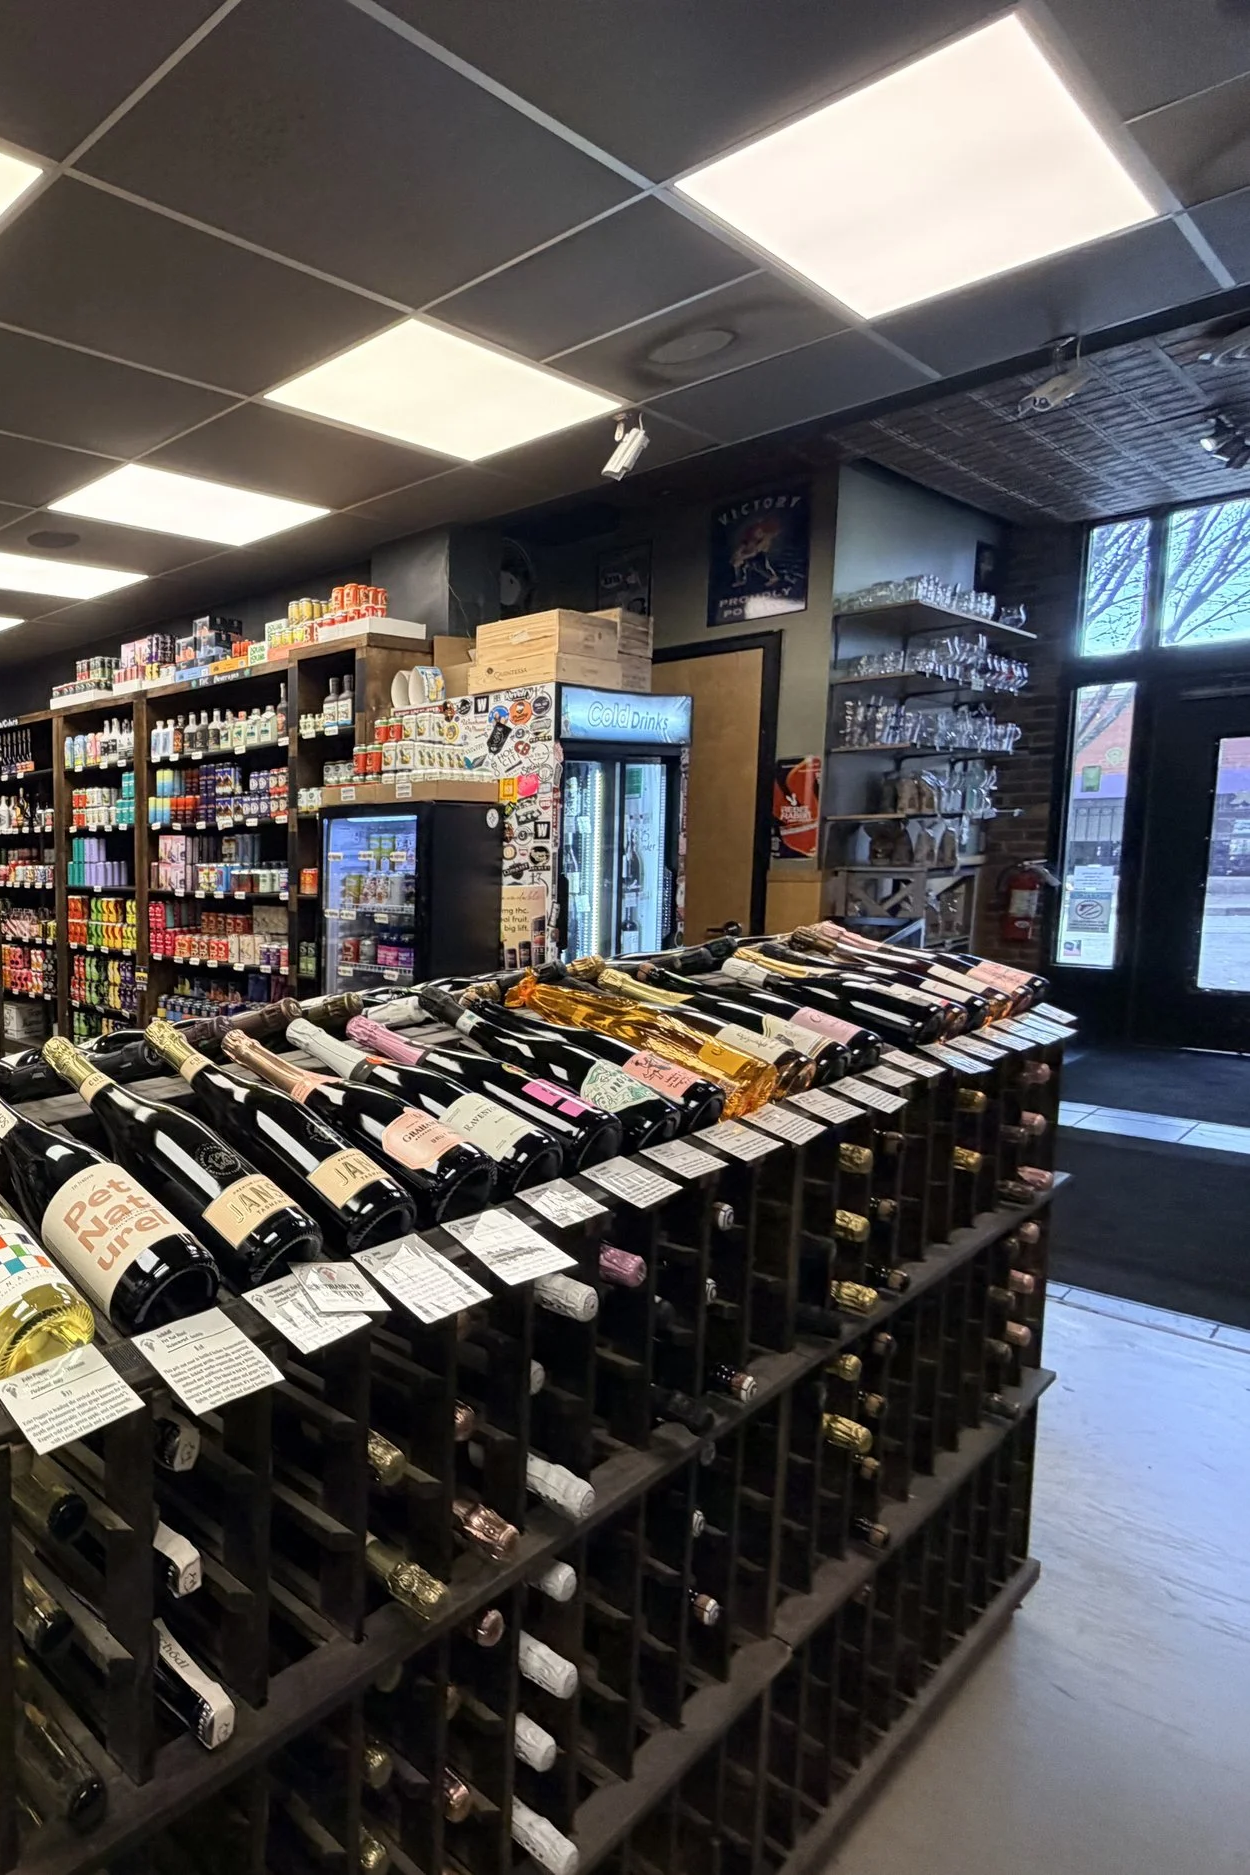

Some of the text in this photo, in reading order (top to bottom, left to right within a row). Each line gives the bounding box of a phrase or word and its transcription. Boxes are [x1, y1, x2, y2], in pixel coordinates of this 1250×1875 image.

[718, 496, 801, 526] VICTORY
[587, 700, 669, 731] Cold Drinks
[504, 924, 529, 933] big lift.
[512, 915, 529, 923] fruit.
[63, 1178, 132, 1233] Pét
[77, 1193, 150, 1253] Nat
[97, 1209, 170, 1272] urel
